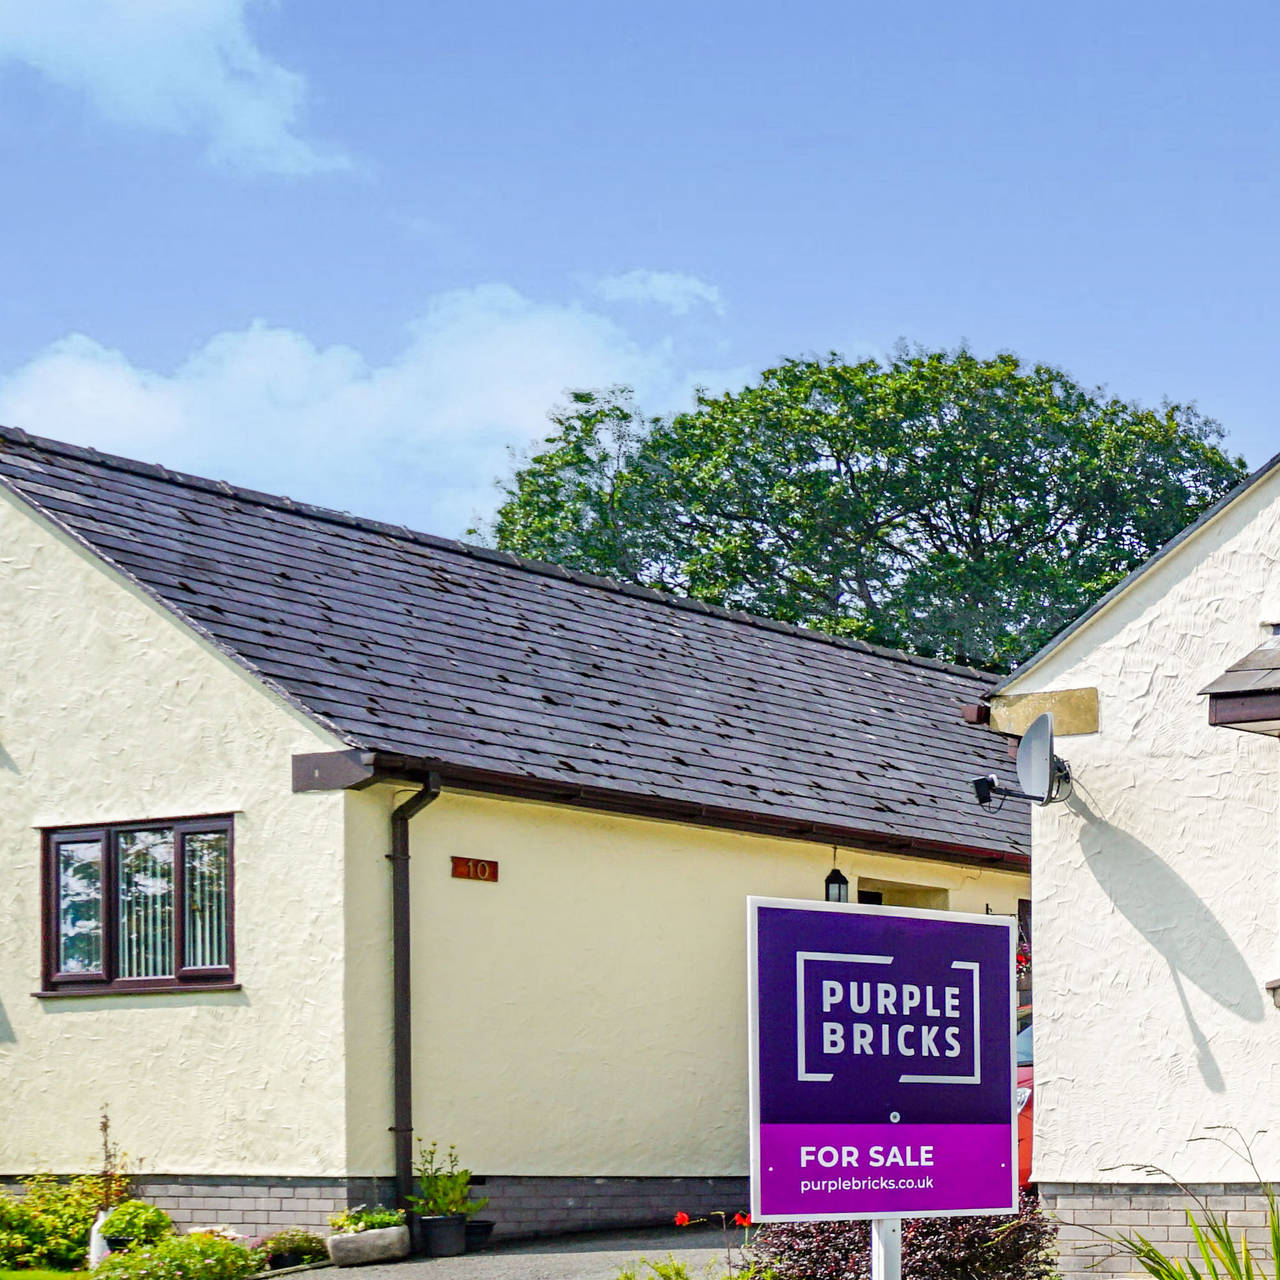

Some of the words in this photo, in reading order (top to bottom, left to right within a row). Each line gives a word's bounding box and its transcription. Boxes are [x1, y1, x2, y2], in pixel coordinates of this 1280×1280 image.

[467, 860, 489, 879] 10
[822, 980, 960, 1018] PURPLE
[822, 1021, 961, 1058] BRICKS
[800, 1146, 859, 1168] FOR
[869, 1145, 934, 1167] SALE
[800, 1175, 934, 1194] purplebricks.co.uk
